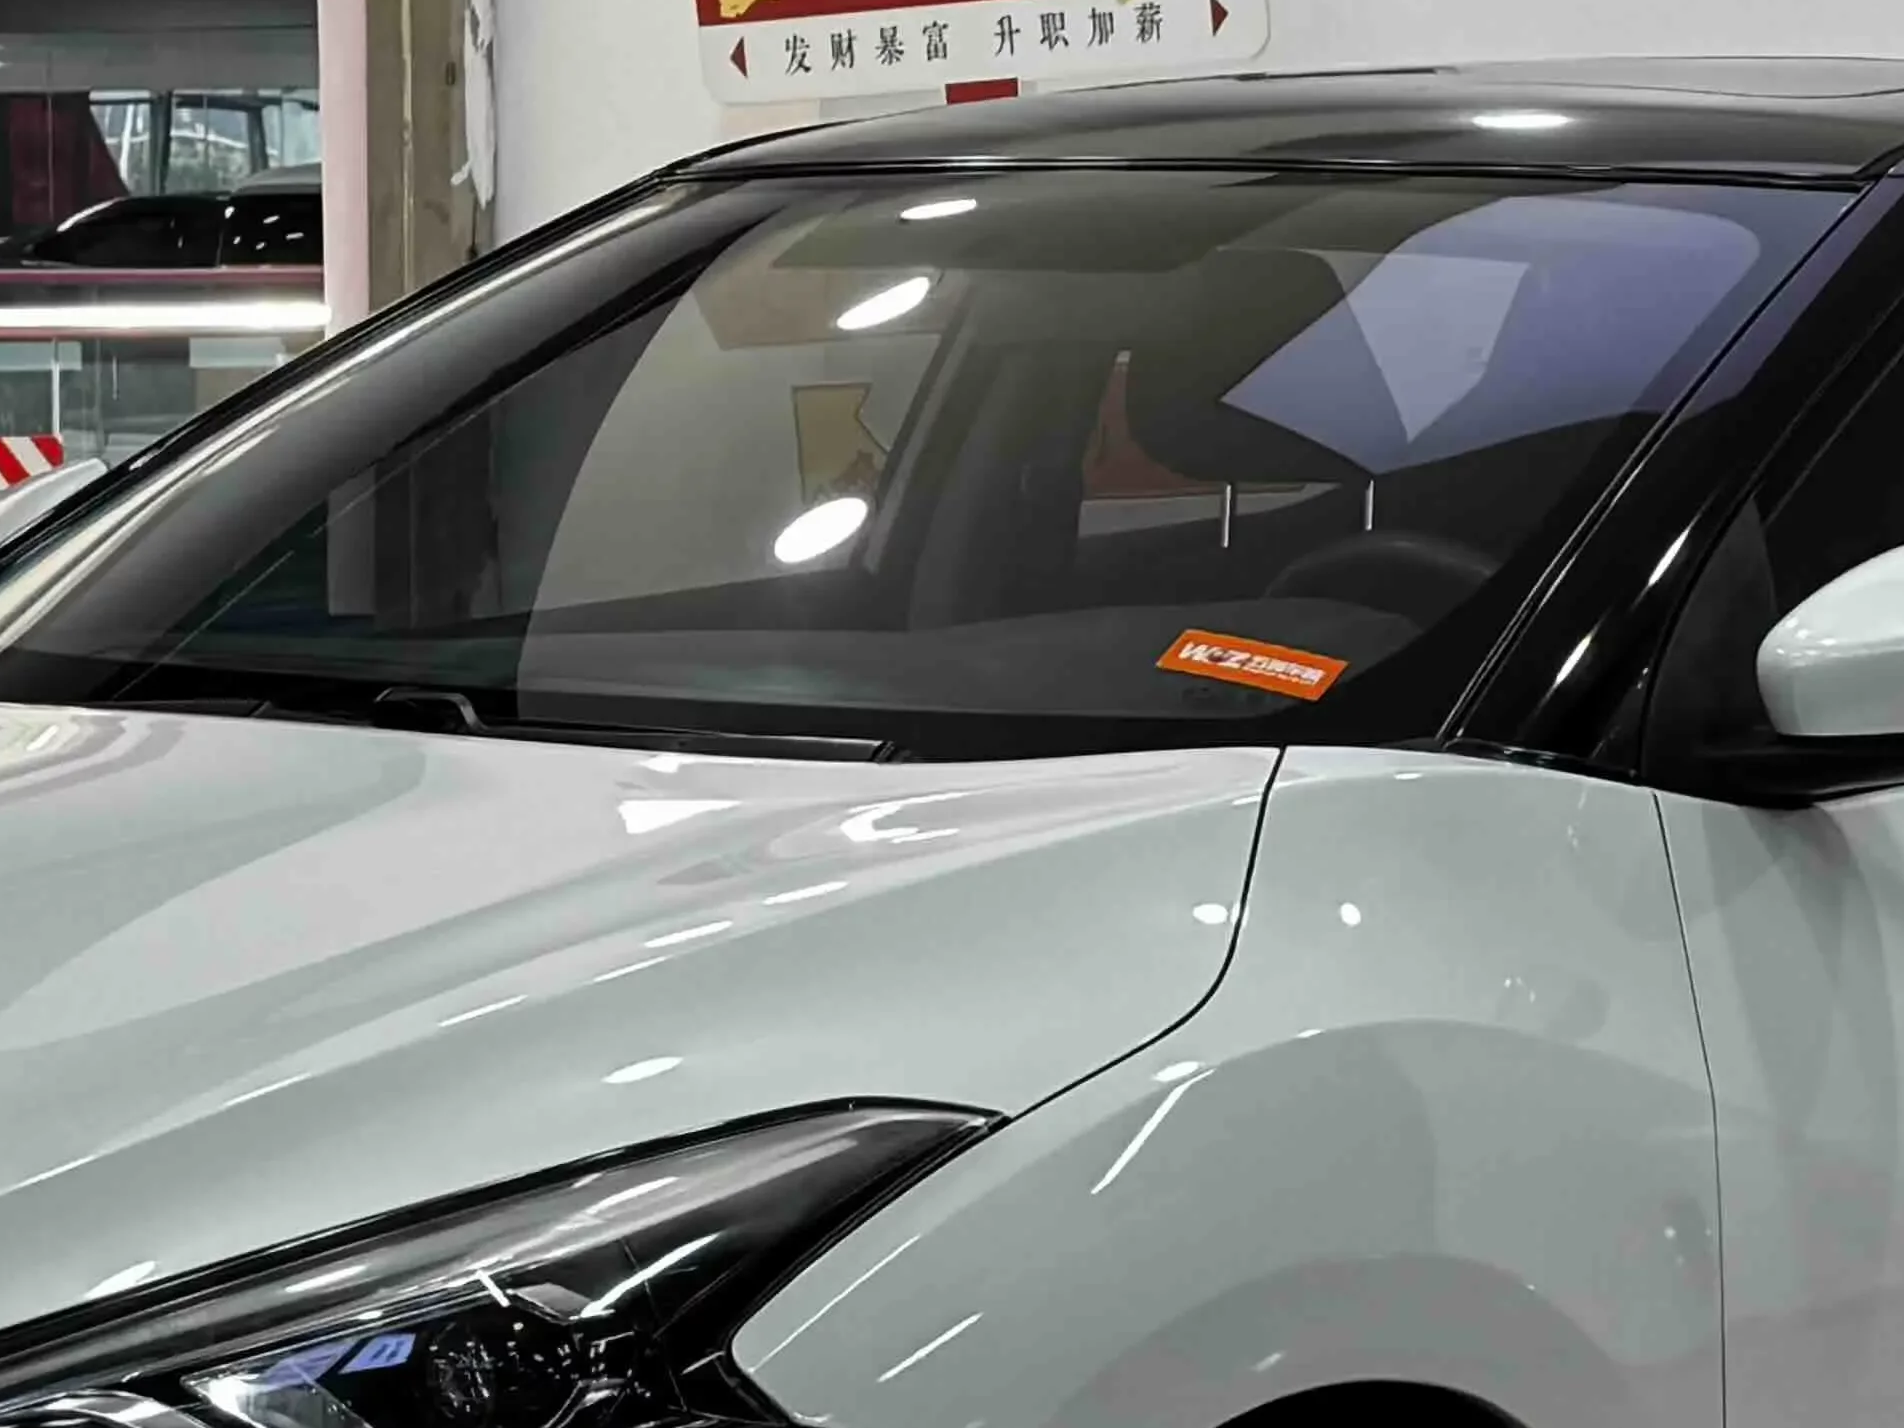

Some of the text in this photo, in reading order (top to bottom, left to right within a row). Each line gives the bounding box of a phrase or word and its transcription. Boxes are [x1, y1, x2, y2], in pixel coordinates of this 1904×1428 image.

[784, 2, 1165, 75] 发财暴富 升职加薪
